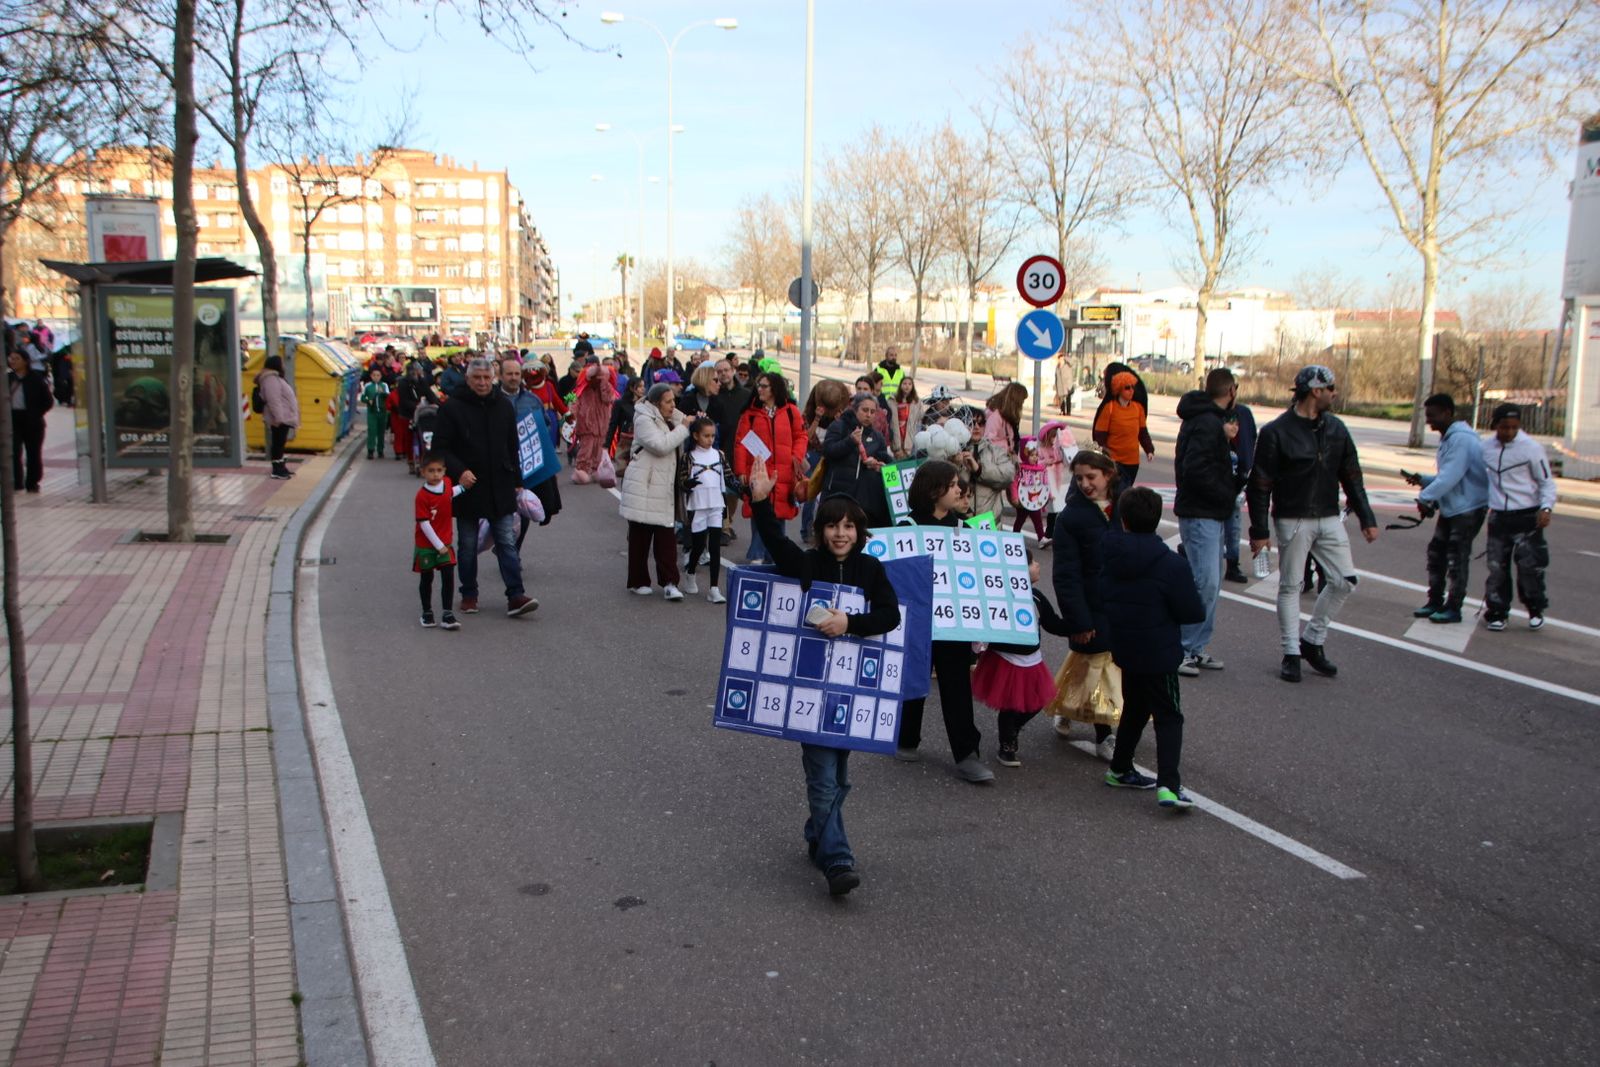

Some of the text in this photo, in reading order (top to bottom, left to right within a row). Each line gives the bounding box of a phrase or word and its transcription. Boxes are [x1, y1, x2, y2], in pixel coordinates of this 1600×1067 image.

[1028, 272, 1055, 290] 30
[885, 471, 897, 482] 26
[896, 499, 903, 508] 6
[430, 509, 438, 520] 7
[896, 538, 1023, 557] 11 37 53 85
[933, 571, 1029, 591] 21 65 93
[776, 596, 795, 612] 10
[934, 605, 1008, 621] 46 59 74
[740, 641, 898, 678] 8 12 41 83
[762, 696, 893, 726] 18 27 67 90
